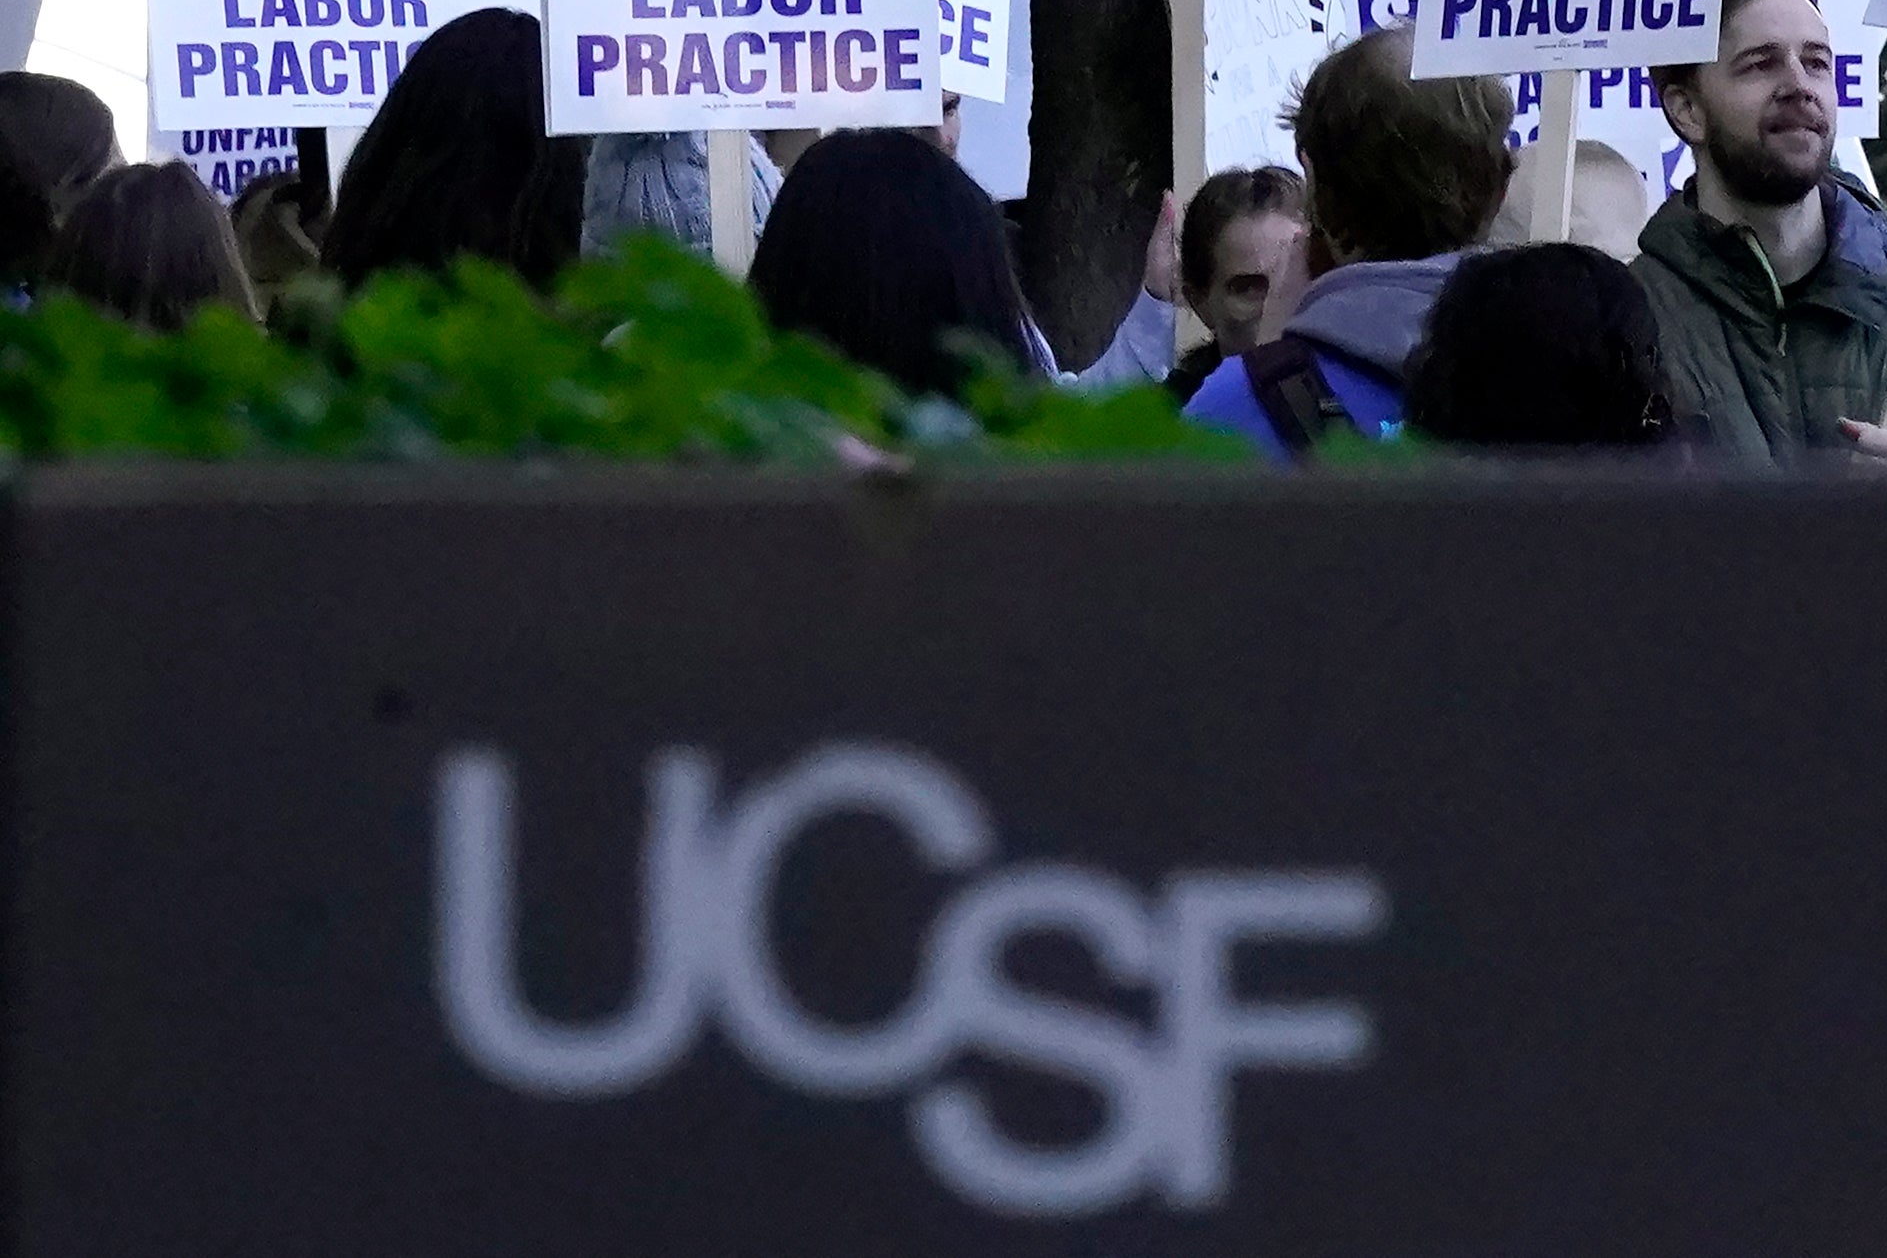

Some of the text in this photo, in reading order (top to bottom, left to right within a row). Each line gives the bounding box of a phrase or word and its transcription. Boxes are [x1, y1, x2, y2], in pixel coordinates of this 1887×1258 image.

[177, 39, 422, 99] PRACTI
[577, 28, 923, 98] PRACTICE
[432, 738, 1390, 1218] UCSF
